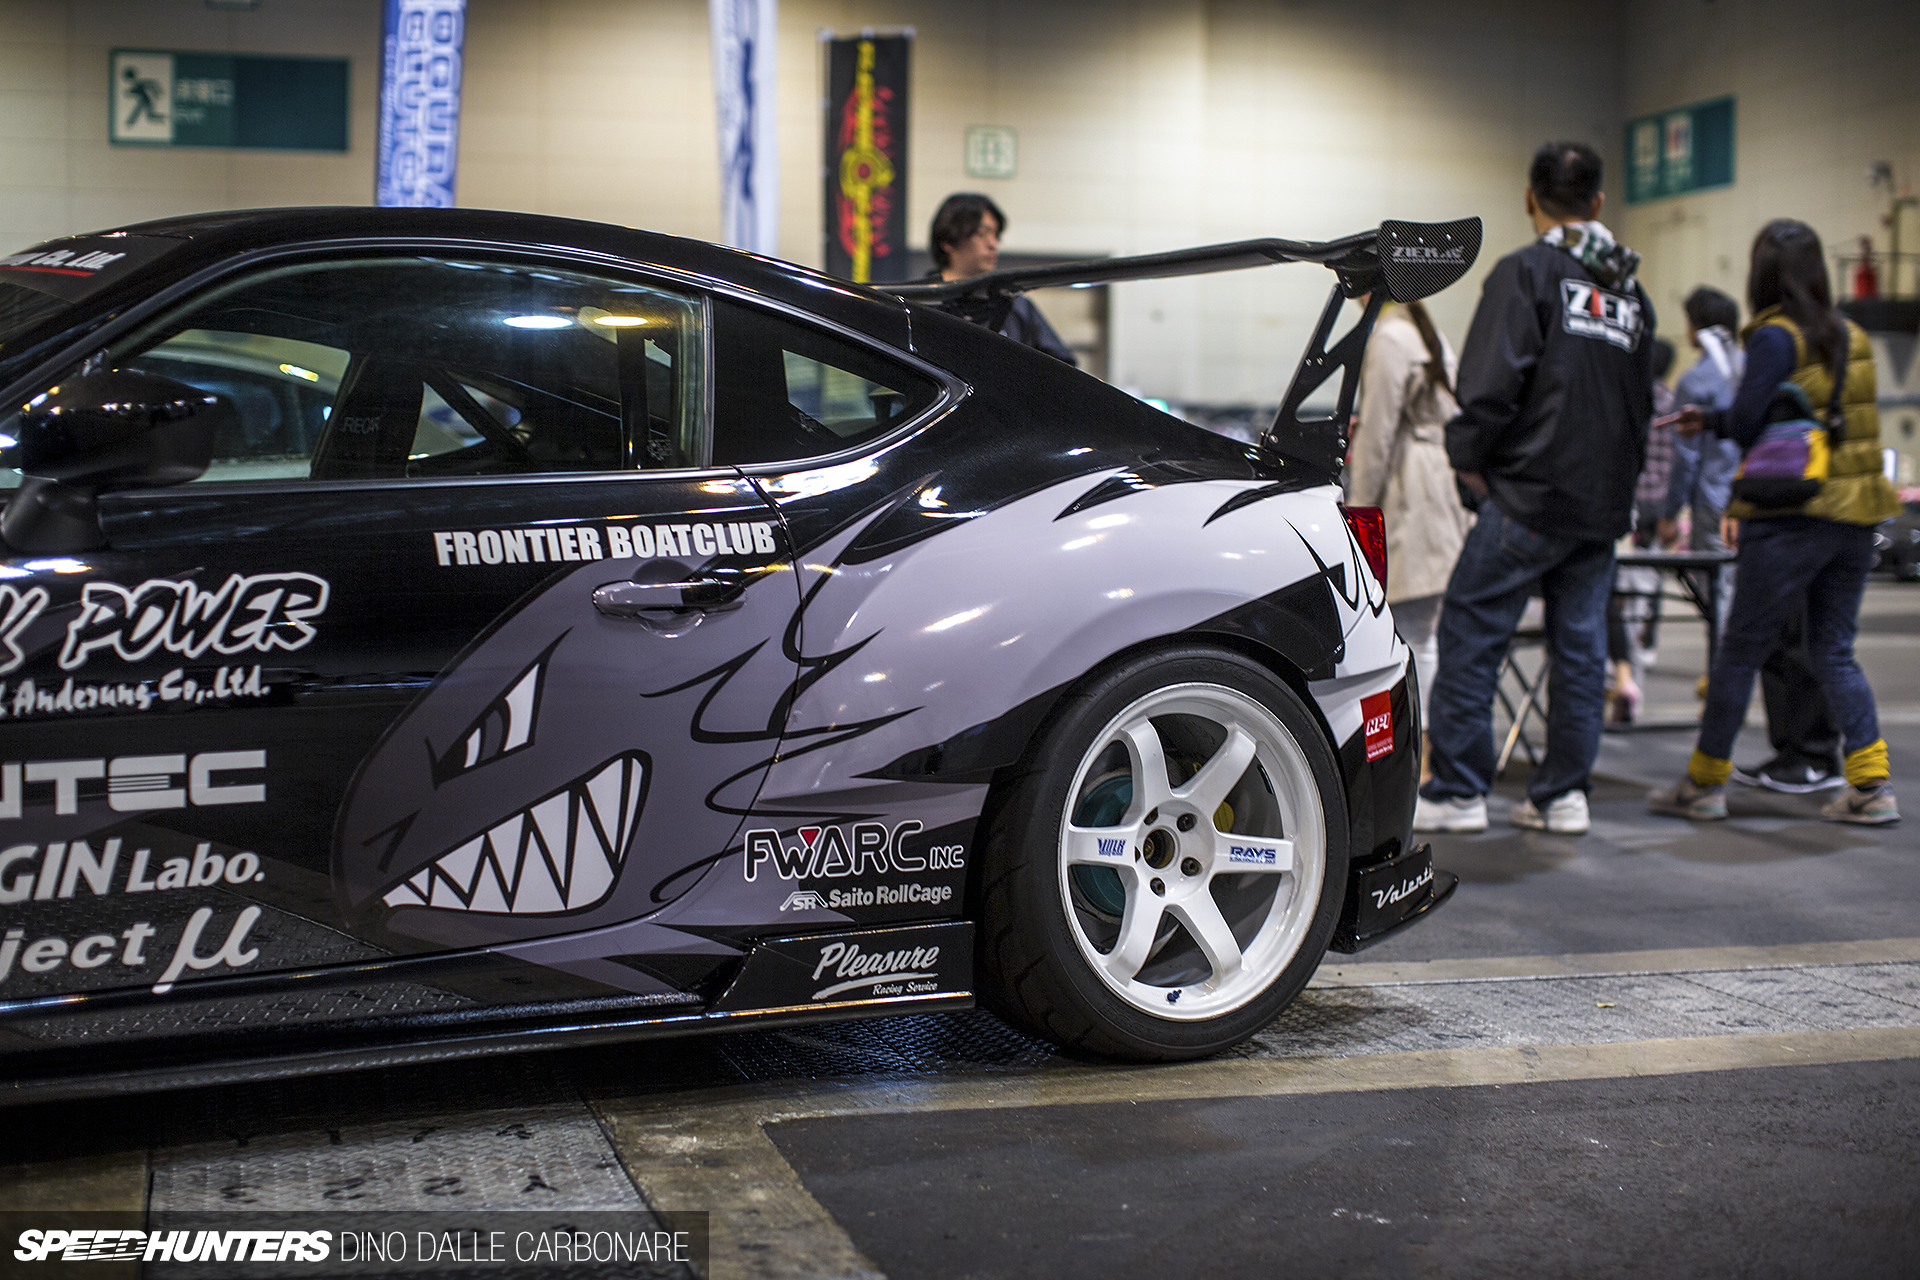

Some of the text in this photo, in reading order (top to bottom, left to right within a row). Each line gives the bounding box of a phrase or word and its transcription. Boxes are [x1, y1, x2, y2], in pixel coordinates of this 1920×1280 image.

[433, 522, 776, 566] FRONTIER BOATCLUB
[58, 572, 330, 671] POWER
[125, 843, 265, 893] Labo.
[929, 845, 965, 870] INC
[1230, 846, 1277, 859] RAYS
[829, 887, 874, 908] Saito
[876, 883, 952, 905] RollCage
[812, 942, 940, 981] Pleasure
[872, 980, 938, 996] Racing Service
